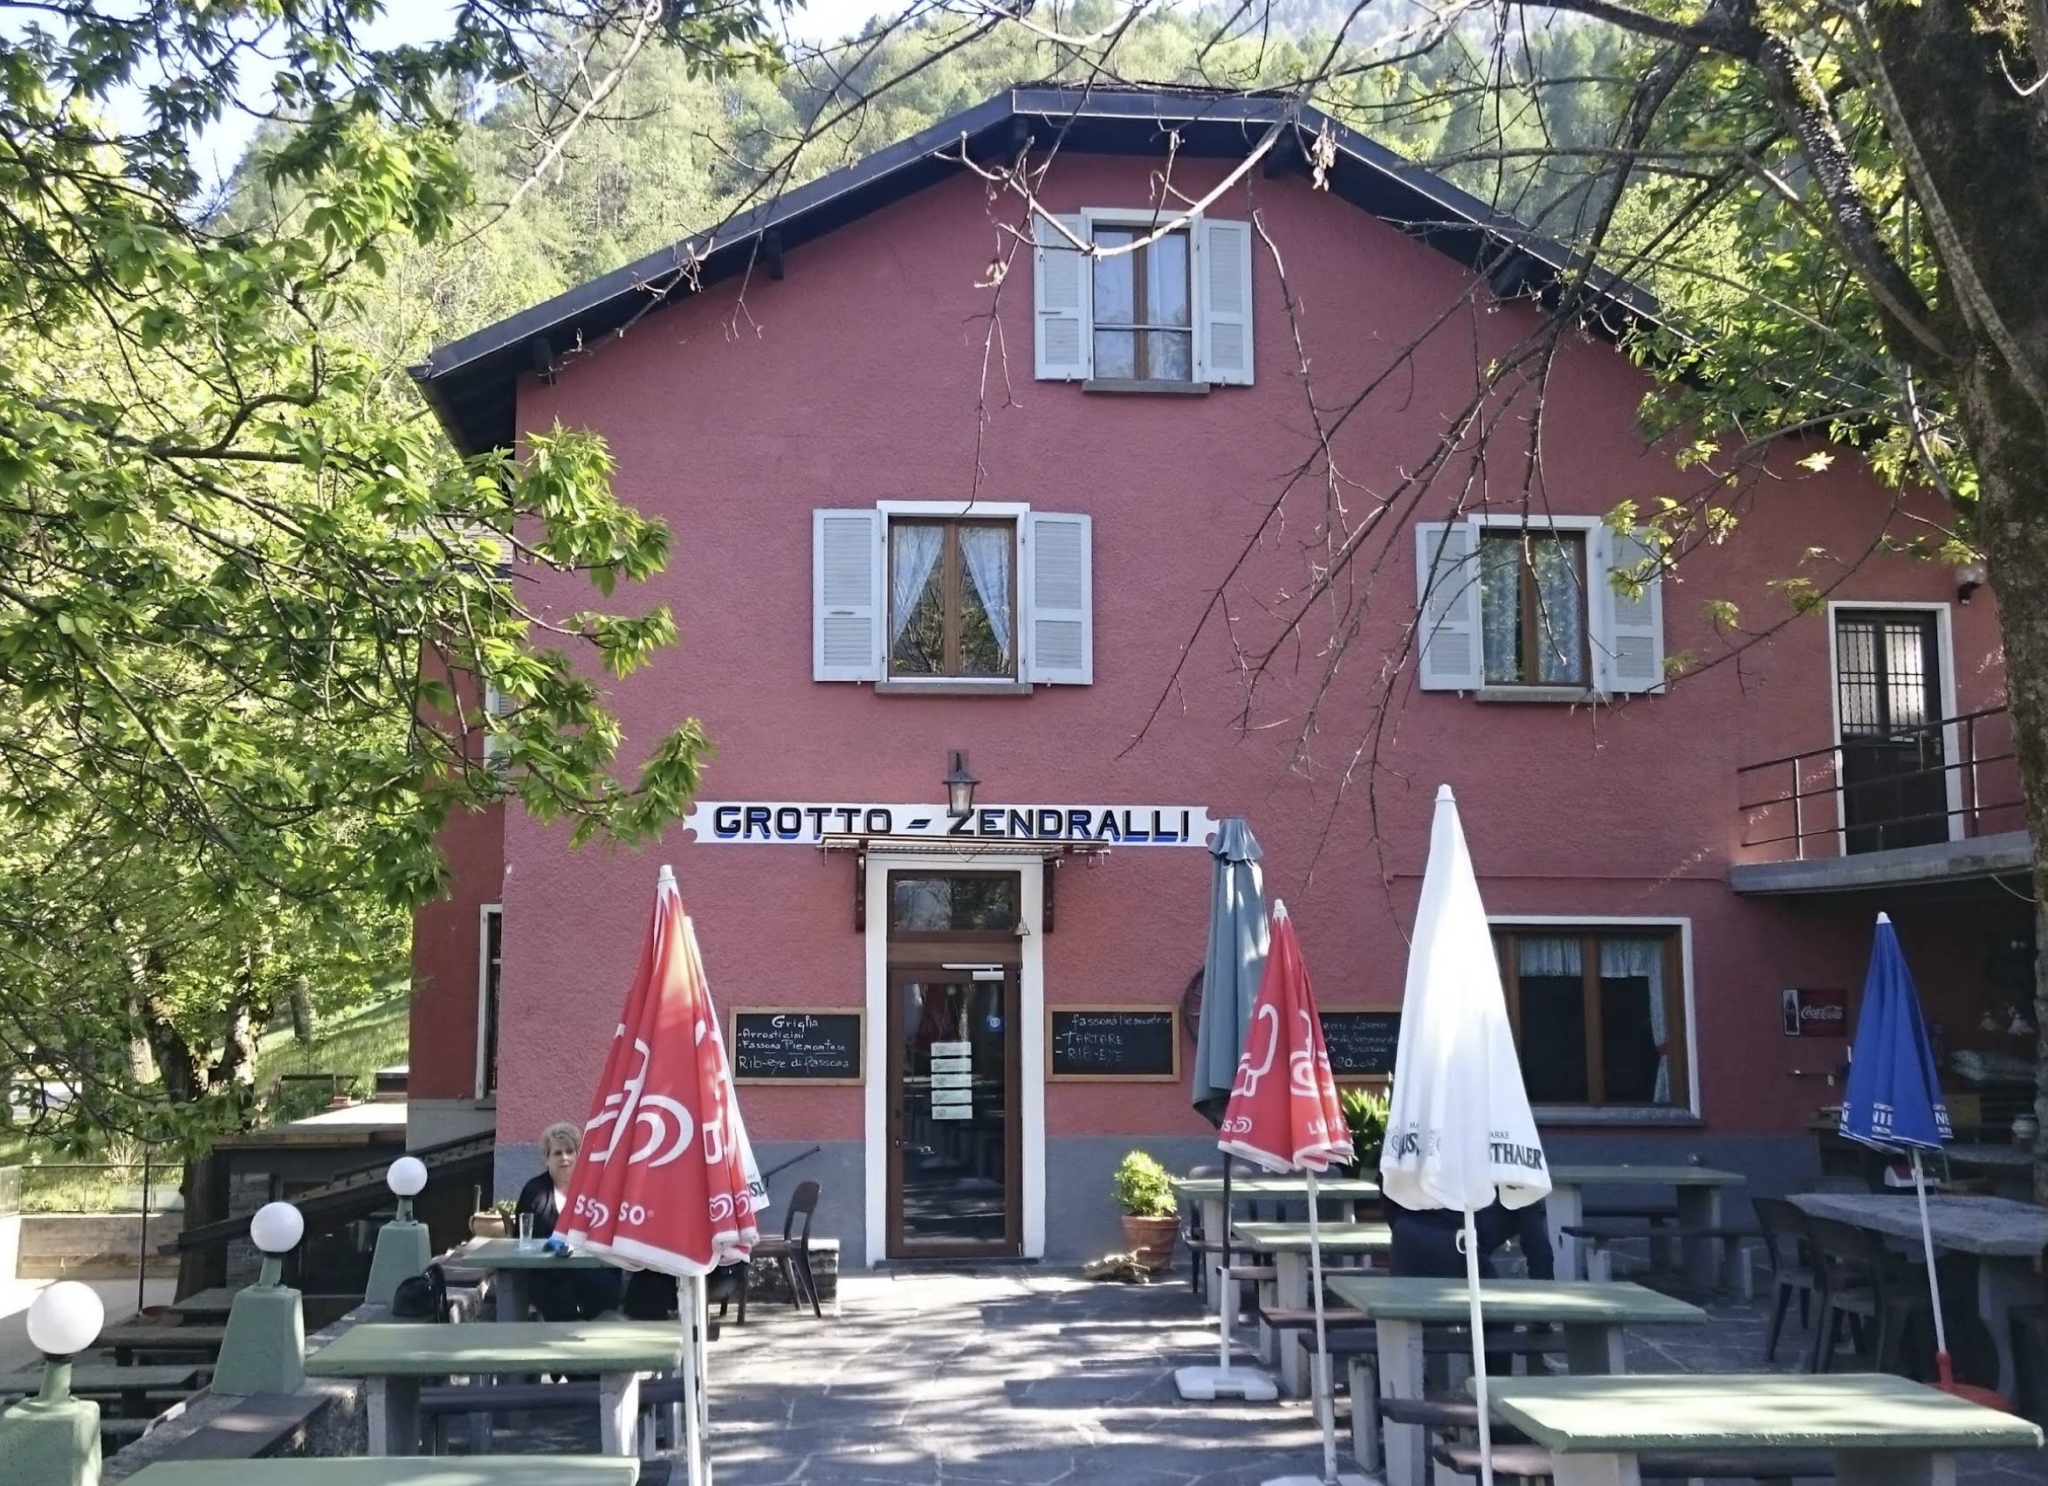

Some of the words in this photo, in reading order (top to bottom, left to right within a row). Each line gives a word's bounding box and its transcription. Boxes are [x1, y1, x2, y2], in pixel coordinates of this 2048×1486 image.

[713, 806, 893, 840] GROTTO
[945, 807, 1190, 843] ZENDRALLI
[771, 1014, 819, 1033] Griglia
